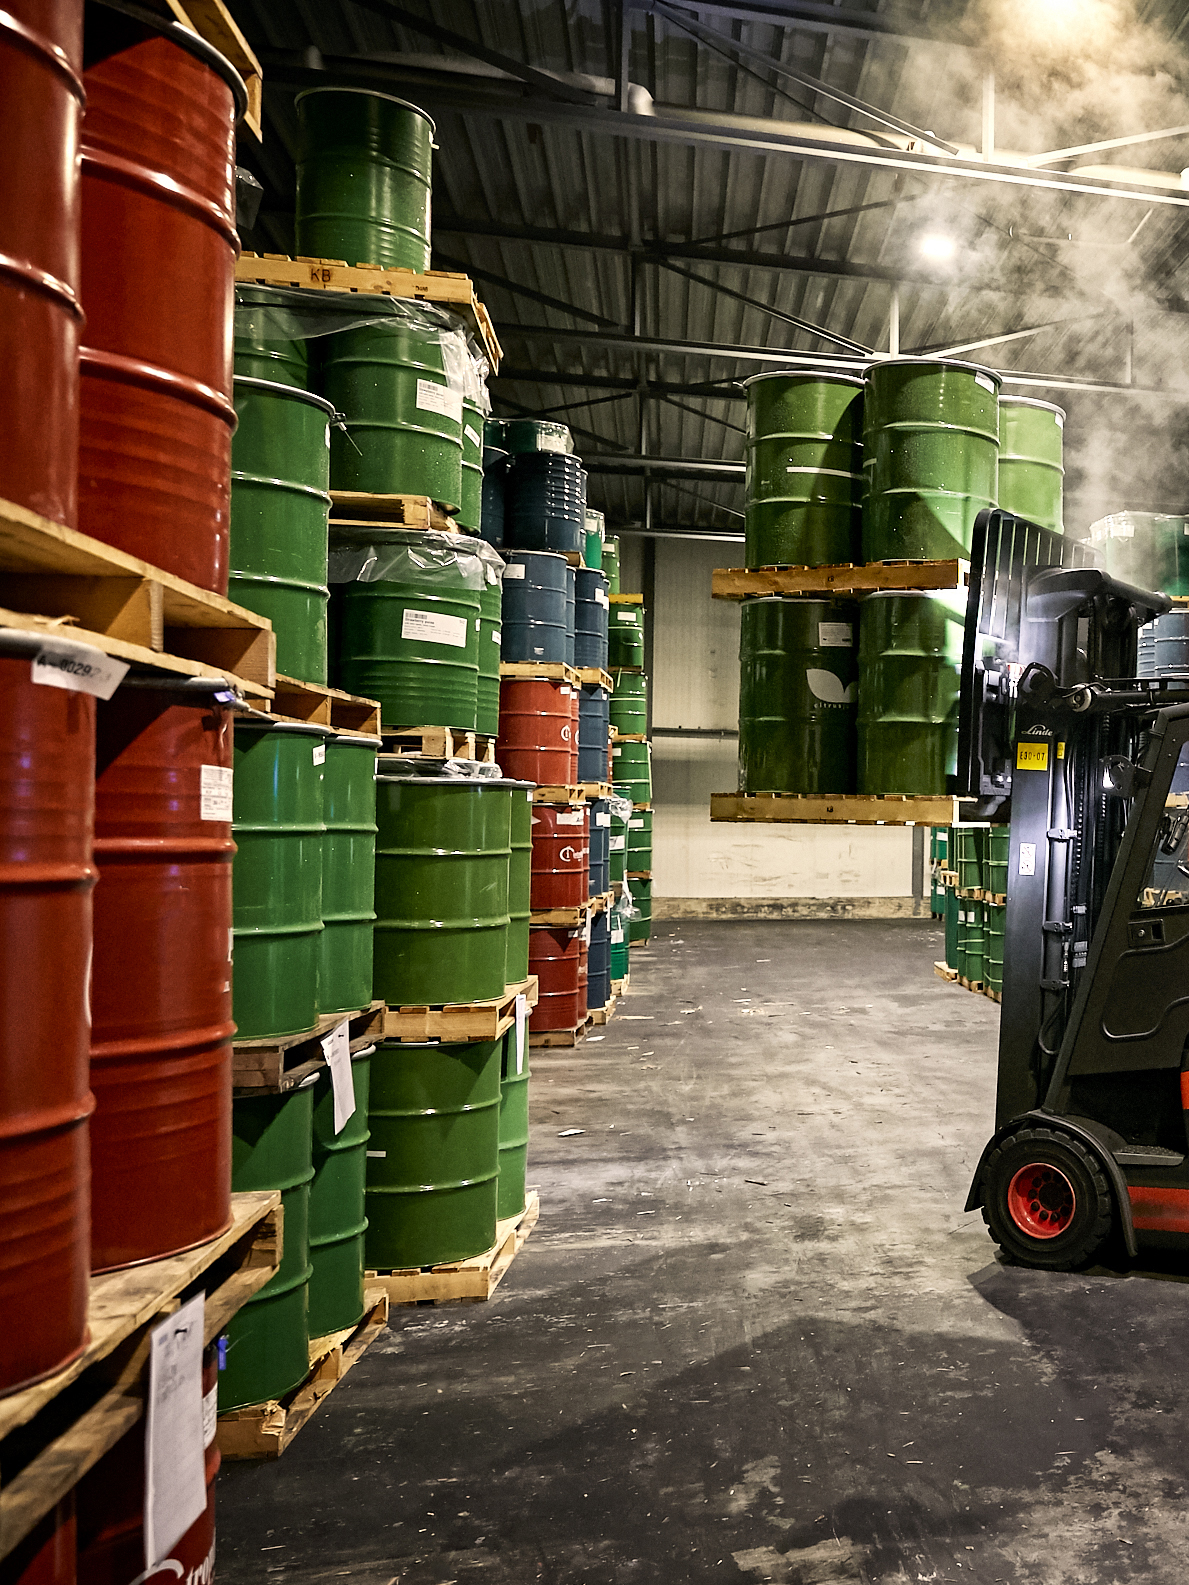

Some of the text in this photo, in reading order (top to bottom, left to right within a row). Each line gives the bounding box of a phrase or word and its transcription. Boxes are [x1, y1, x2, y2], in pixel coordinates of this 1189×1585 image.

[310, 268, 331, 282] KB
[1021, 724, 1053, 736] Linde
[1019, 751, 1045, 761] E30-07
